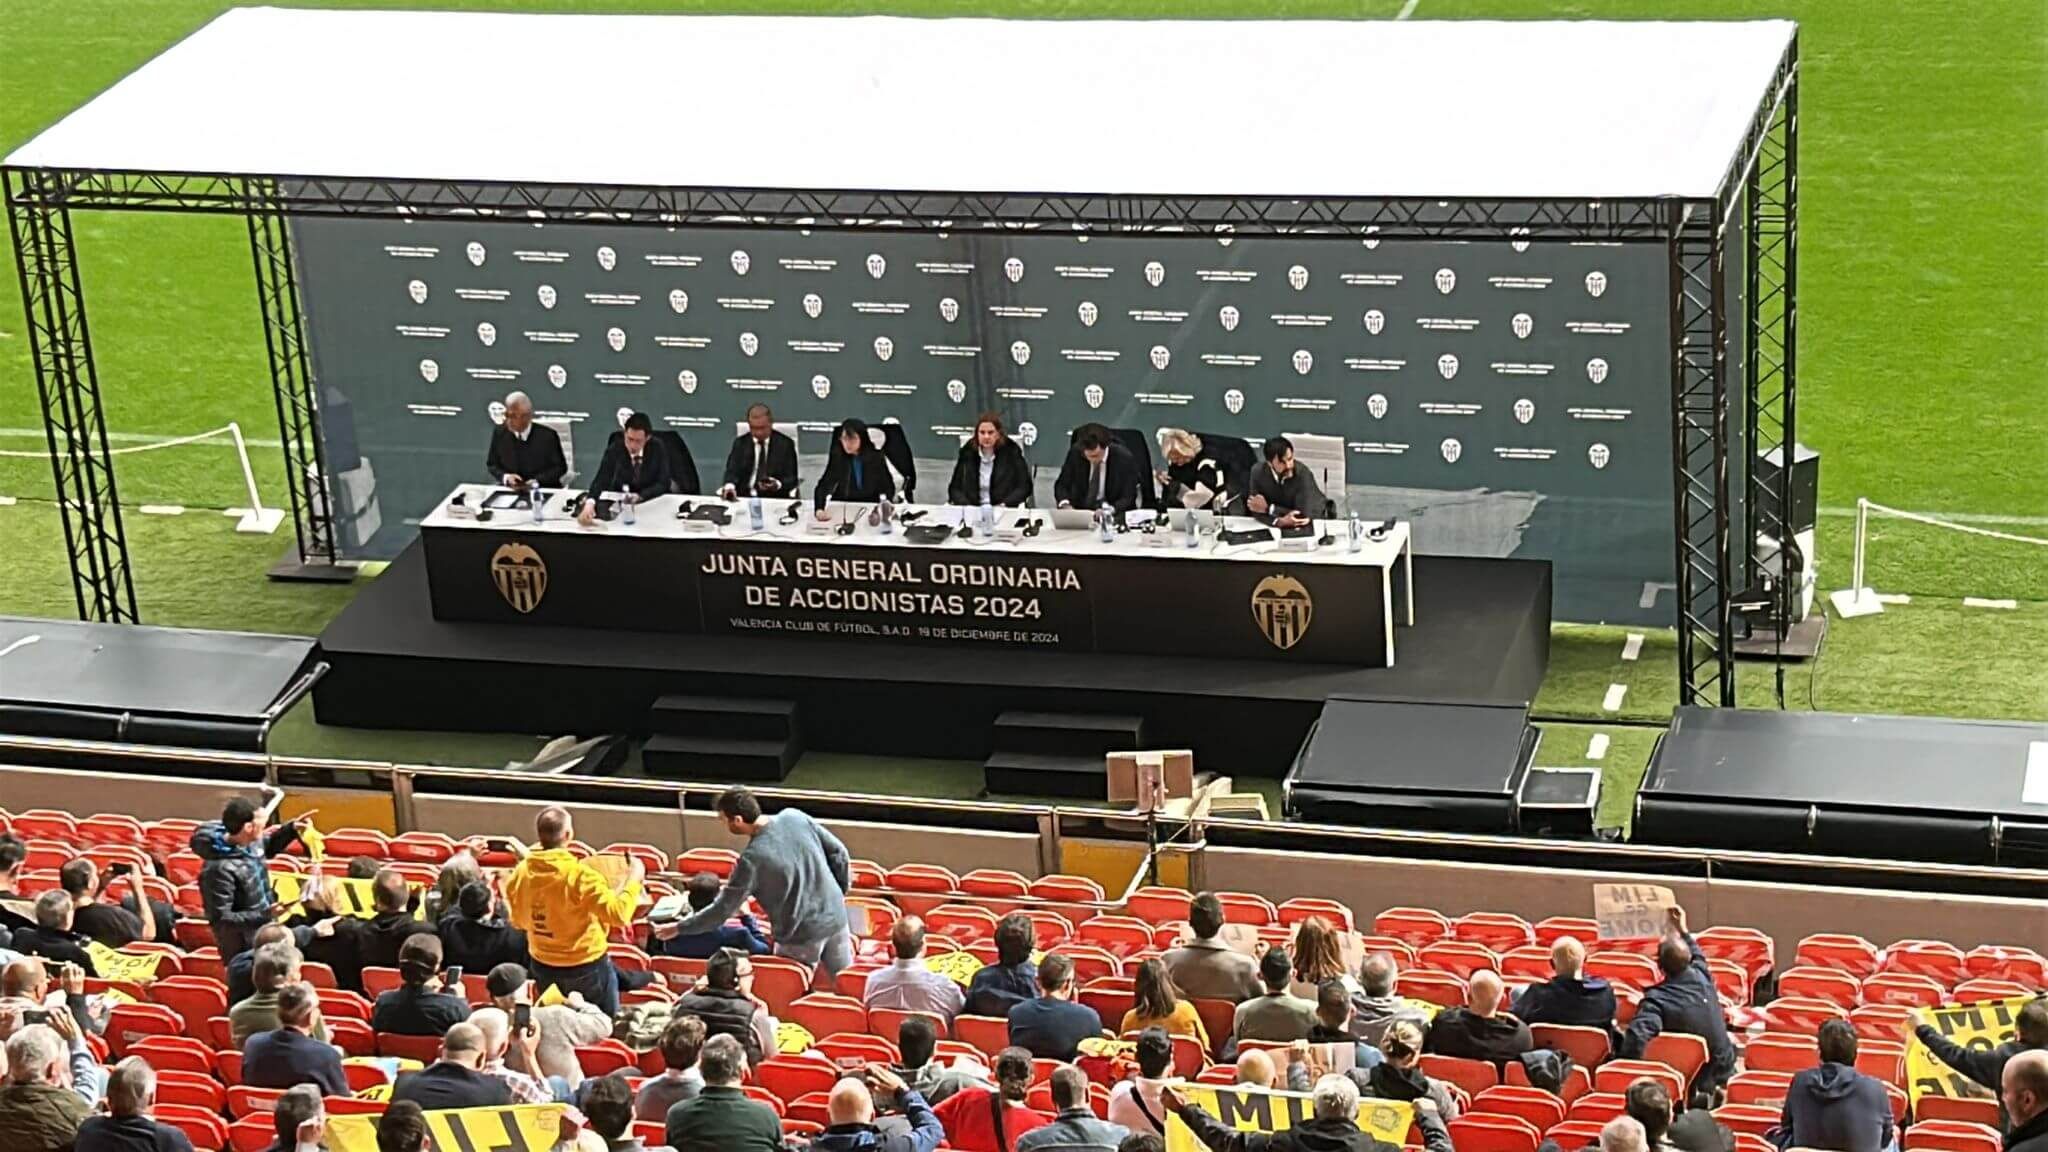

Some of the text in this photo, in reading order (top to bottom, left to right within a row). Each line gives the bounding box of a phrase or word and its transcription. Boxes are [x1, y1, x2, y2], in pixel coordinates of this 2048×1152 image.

[701, 553, 1081, 590] JUNTA GENERAL ORDINARIA
[745, 585, 1042, 619] DE ACCIONISTAS 2024
[730, 618, 782, 629] VALENCIA
[785, 620, 814, 631] CLUB
[933, 628, 947, 638] DE
[1031, 632, 1059, 643] 2024
